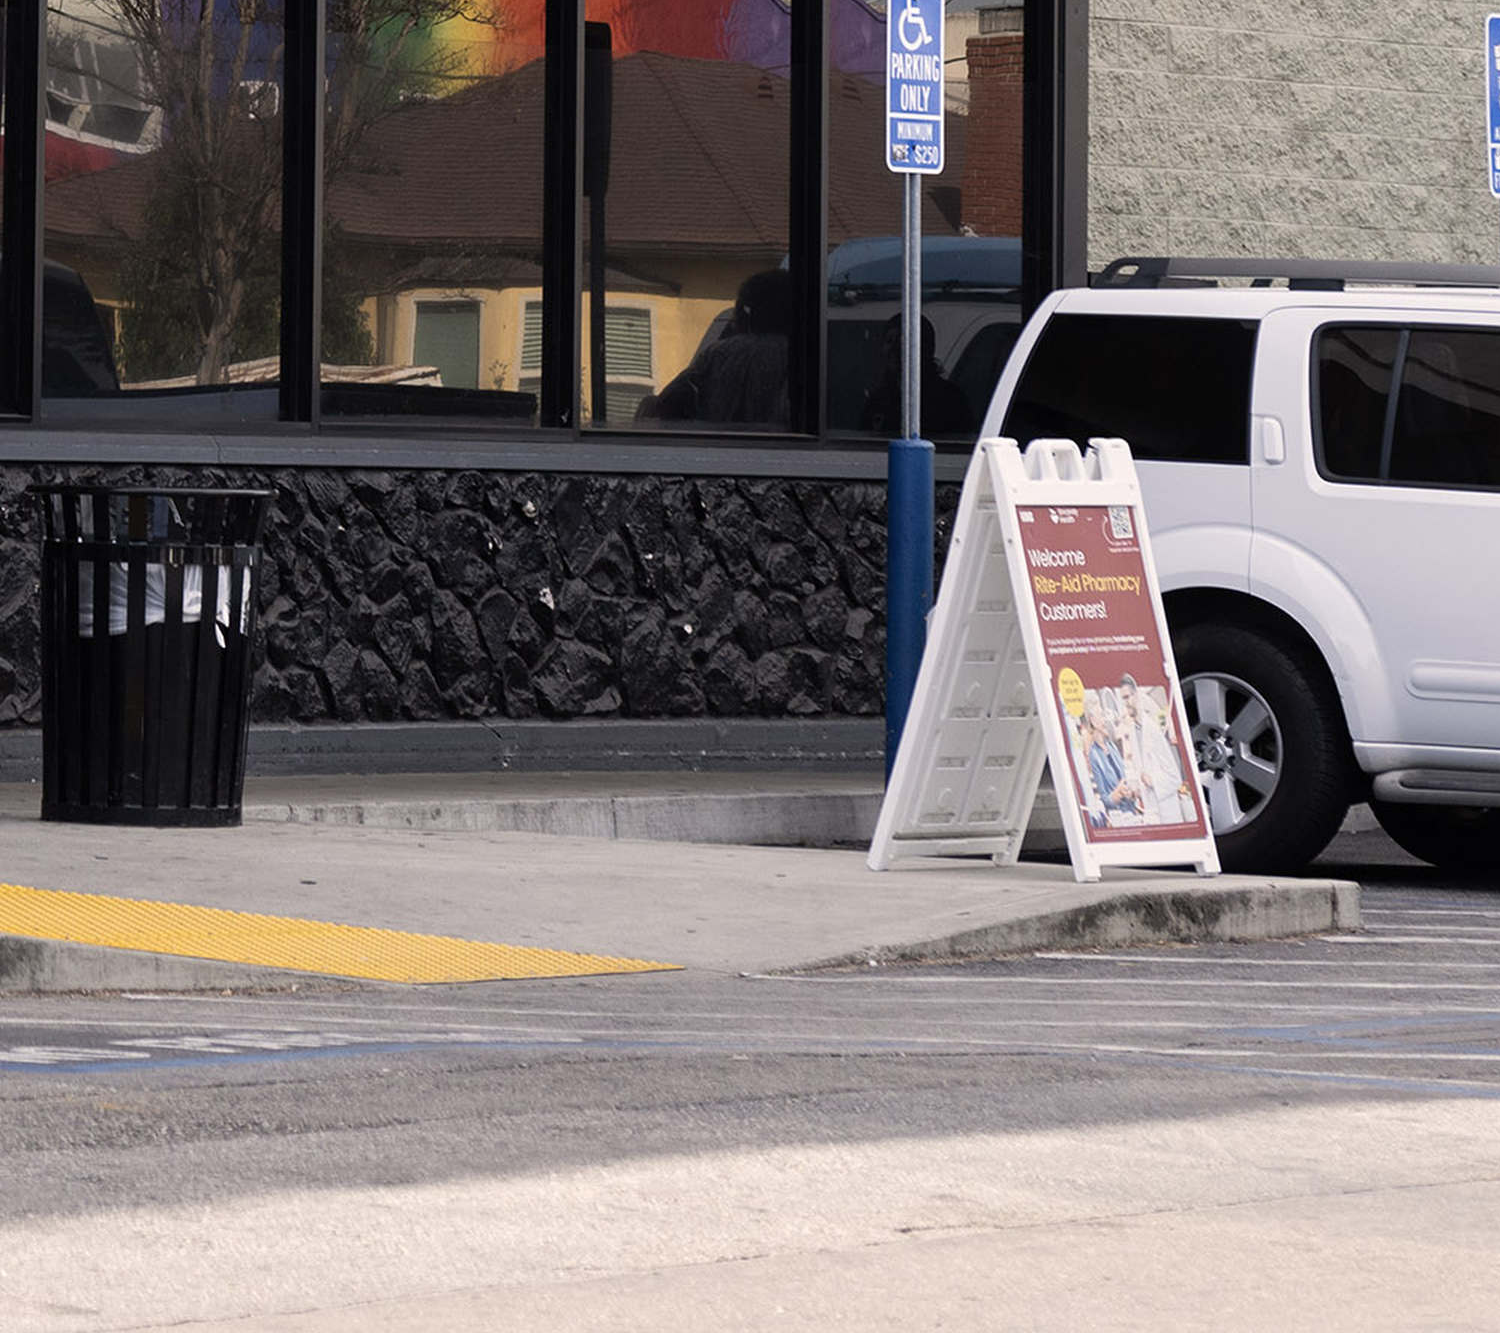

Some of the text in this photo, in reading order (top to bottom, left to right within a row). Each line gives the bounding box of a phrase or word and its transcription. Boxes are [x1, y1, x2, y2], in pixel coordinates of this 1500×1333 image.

[891, 52, 940, 82] PARKING
[900, 83, 931, 112] ONLY
[914, 144, 939, 165] $250
[1027, 548, 1086, 567] Welcome
[1032, 573, 1141, 596] Rite-Aid Pharmacy
[1040, 600, 1108, 621] Customers!
